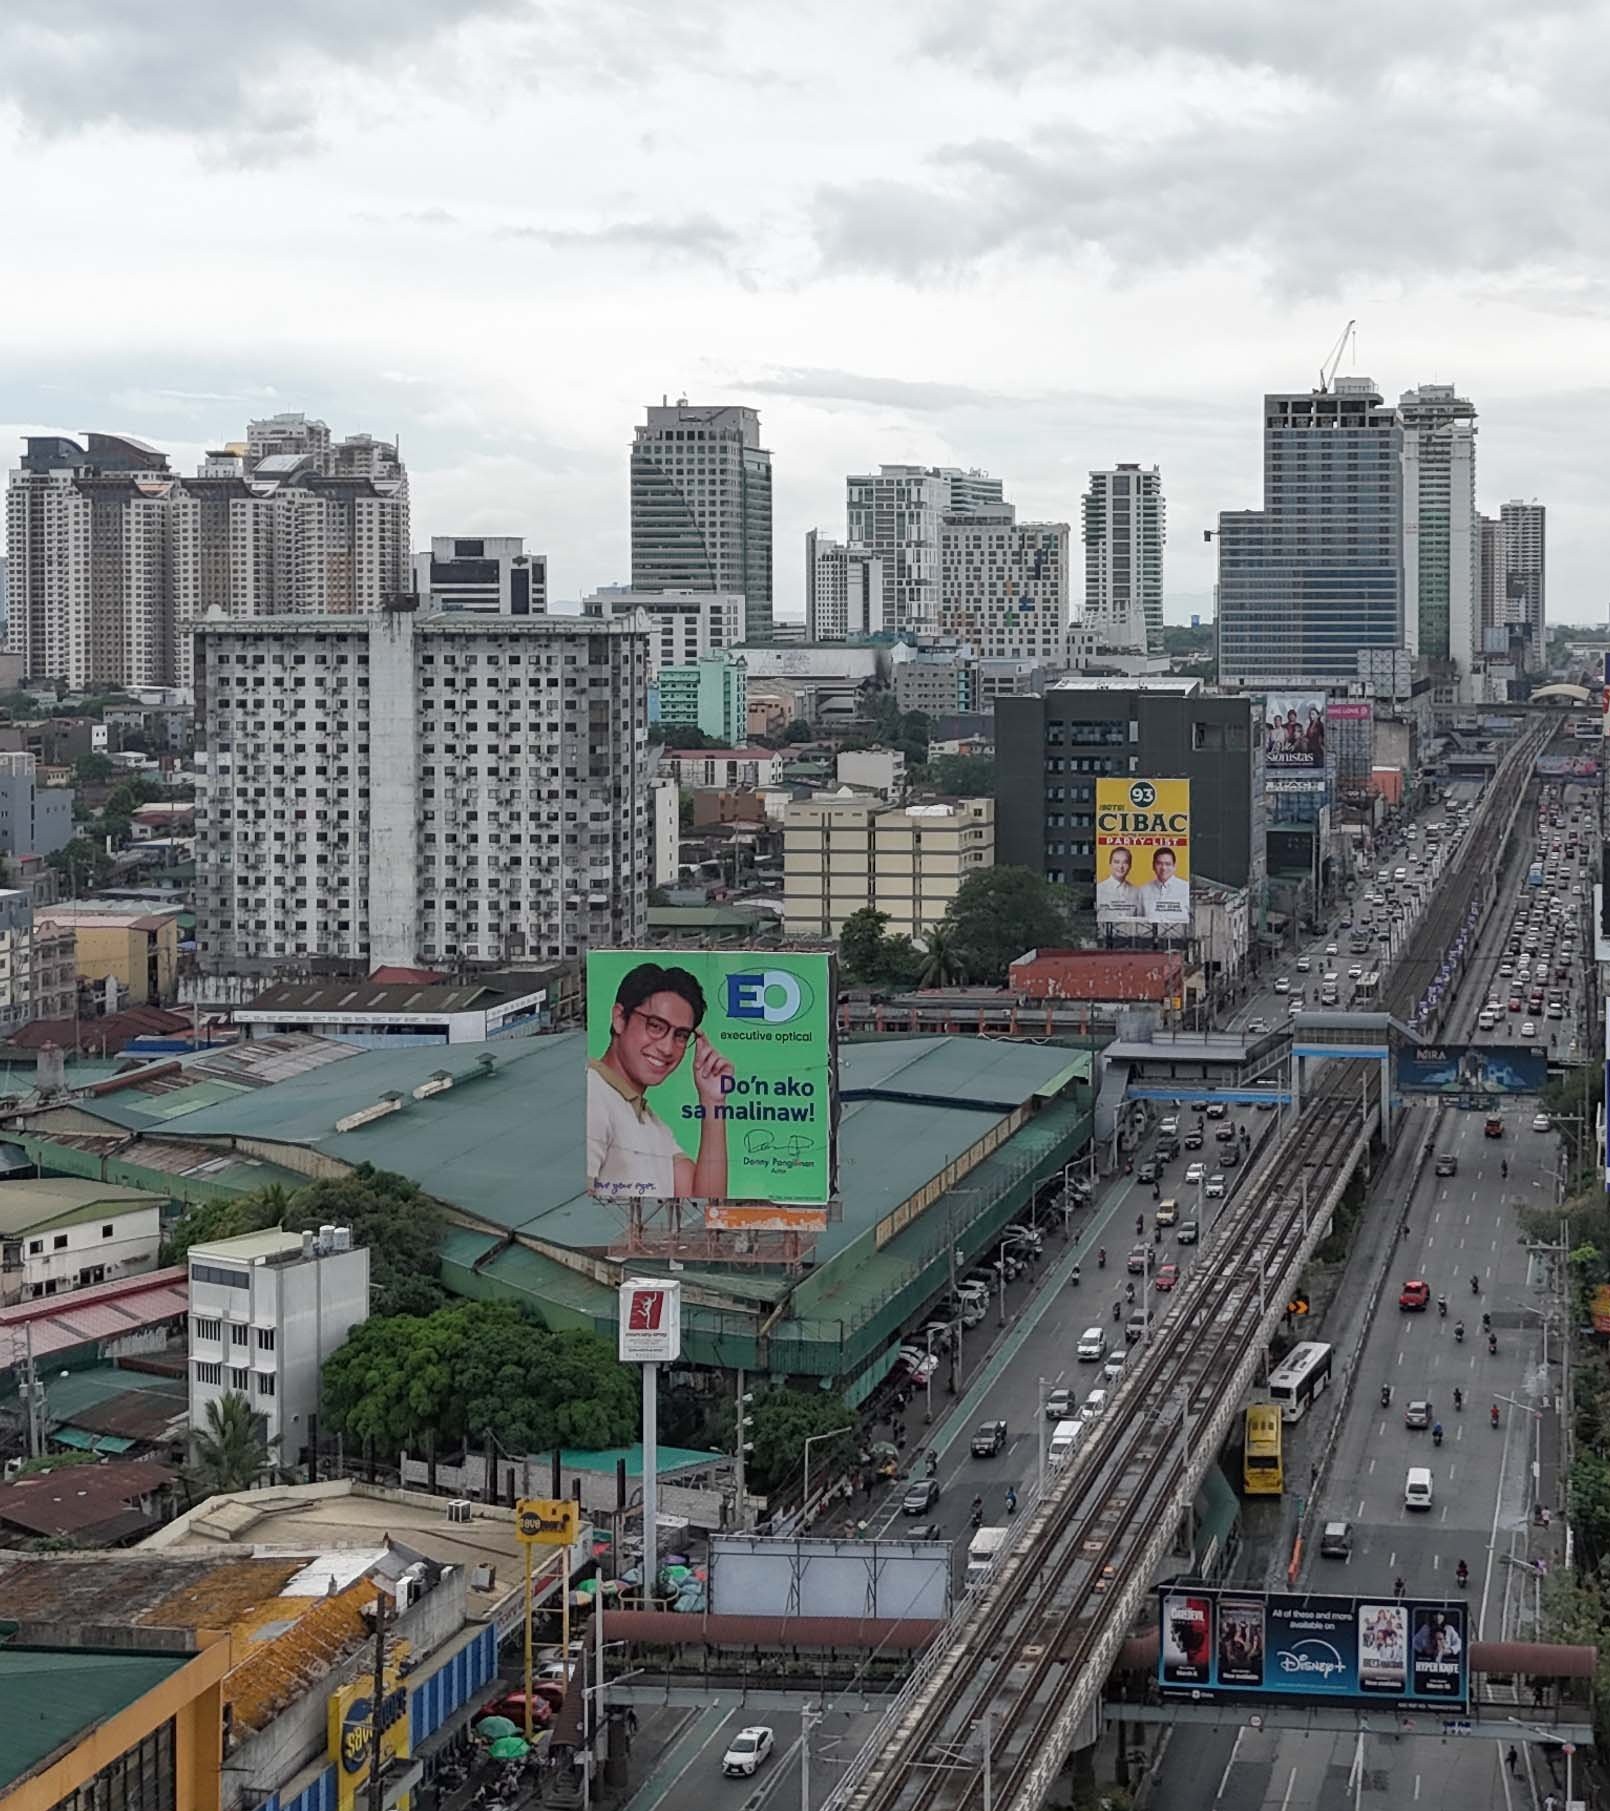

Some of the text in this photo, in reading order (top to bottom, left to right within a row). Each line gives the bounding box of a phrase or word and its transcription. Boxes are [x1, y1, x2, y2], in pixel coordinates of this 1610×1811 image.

[1132, 788, 1154, 802] 93
[1098, 813, 1188, 832] CIBAC
[726, 970, 801, 1024] EO
[720, 1031, 813, 1044] executive optical
[774, 1076, 814, 1096] ako
[681, 1101, 815, 1122] sa malinaw!
[1315, 1611, 1331, 1620] and
